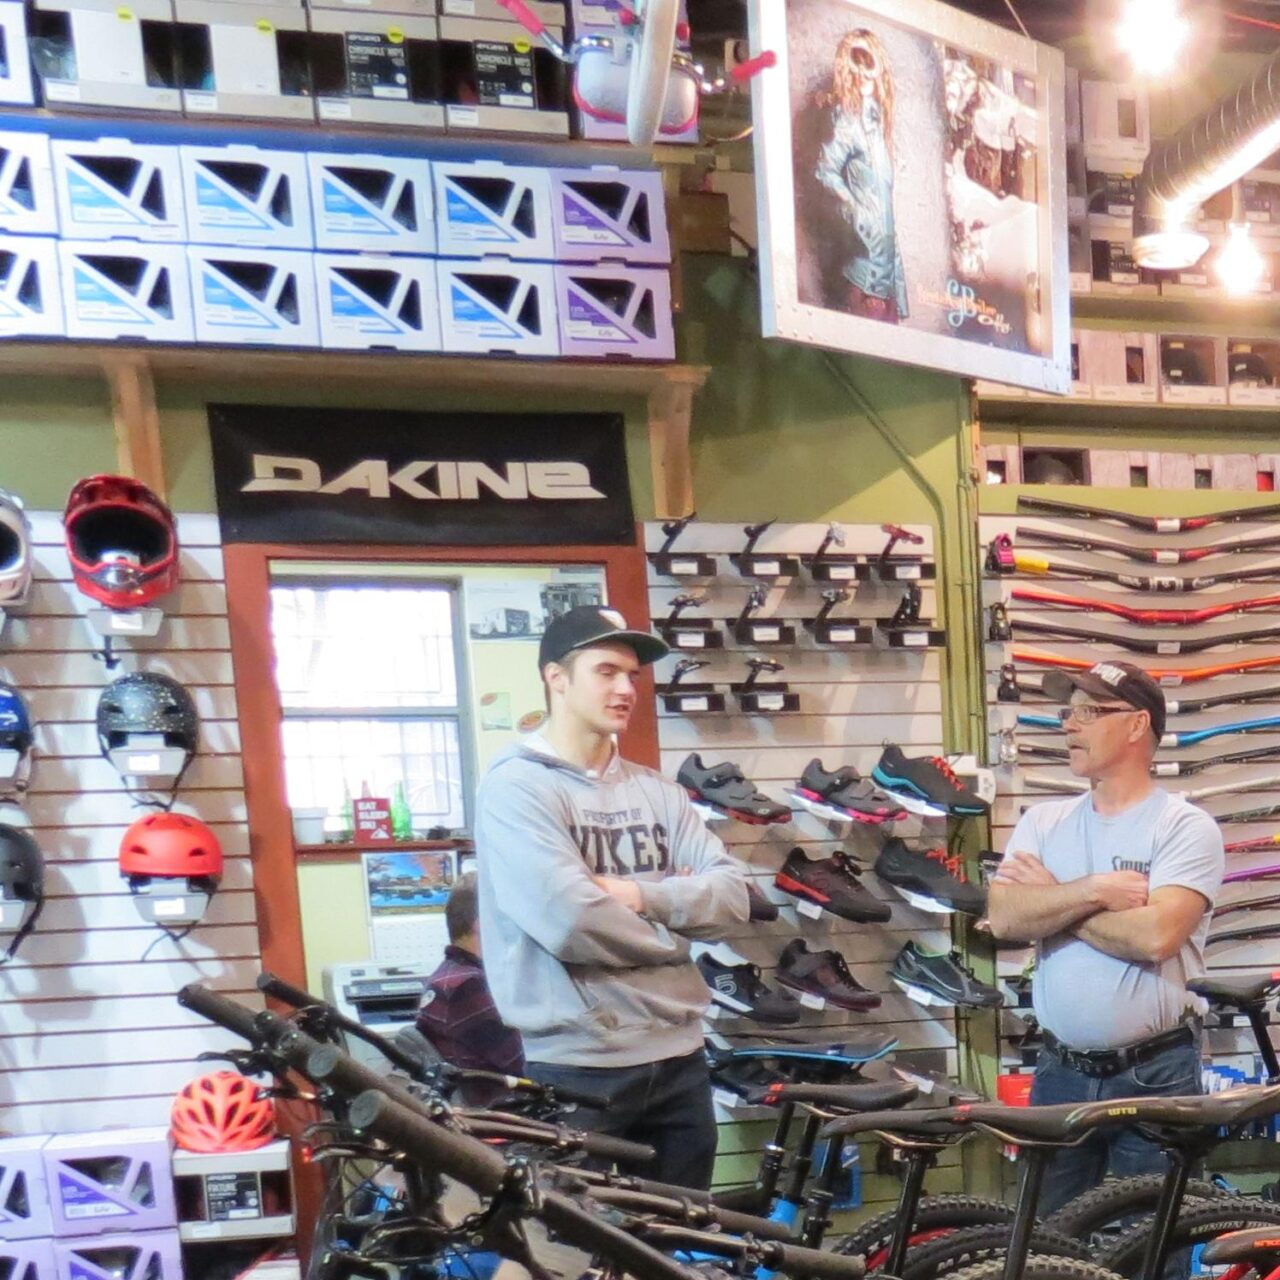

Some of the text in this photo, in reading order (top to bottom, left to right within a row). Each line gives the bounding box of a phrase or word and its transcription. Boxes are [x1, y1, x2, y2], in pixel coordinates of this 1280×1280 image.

[240, 453, 608, 500] DAKINE
[357, 802, 377, 810] EAT
[582, 807, 641, 825] PROPERTY OF
[359, 820, 377, 829] SKI
[1108, 1107, 1137, 1116] WTB
